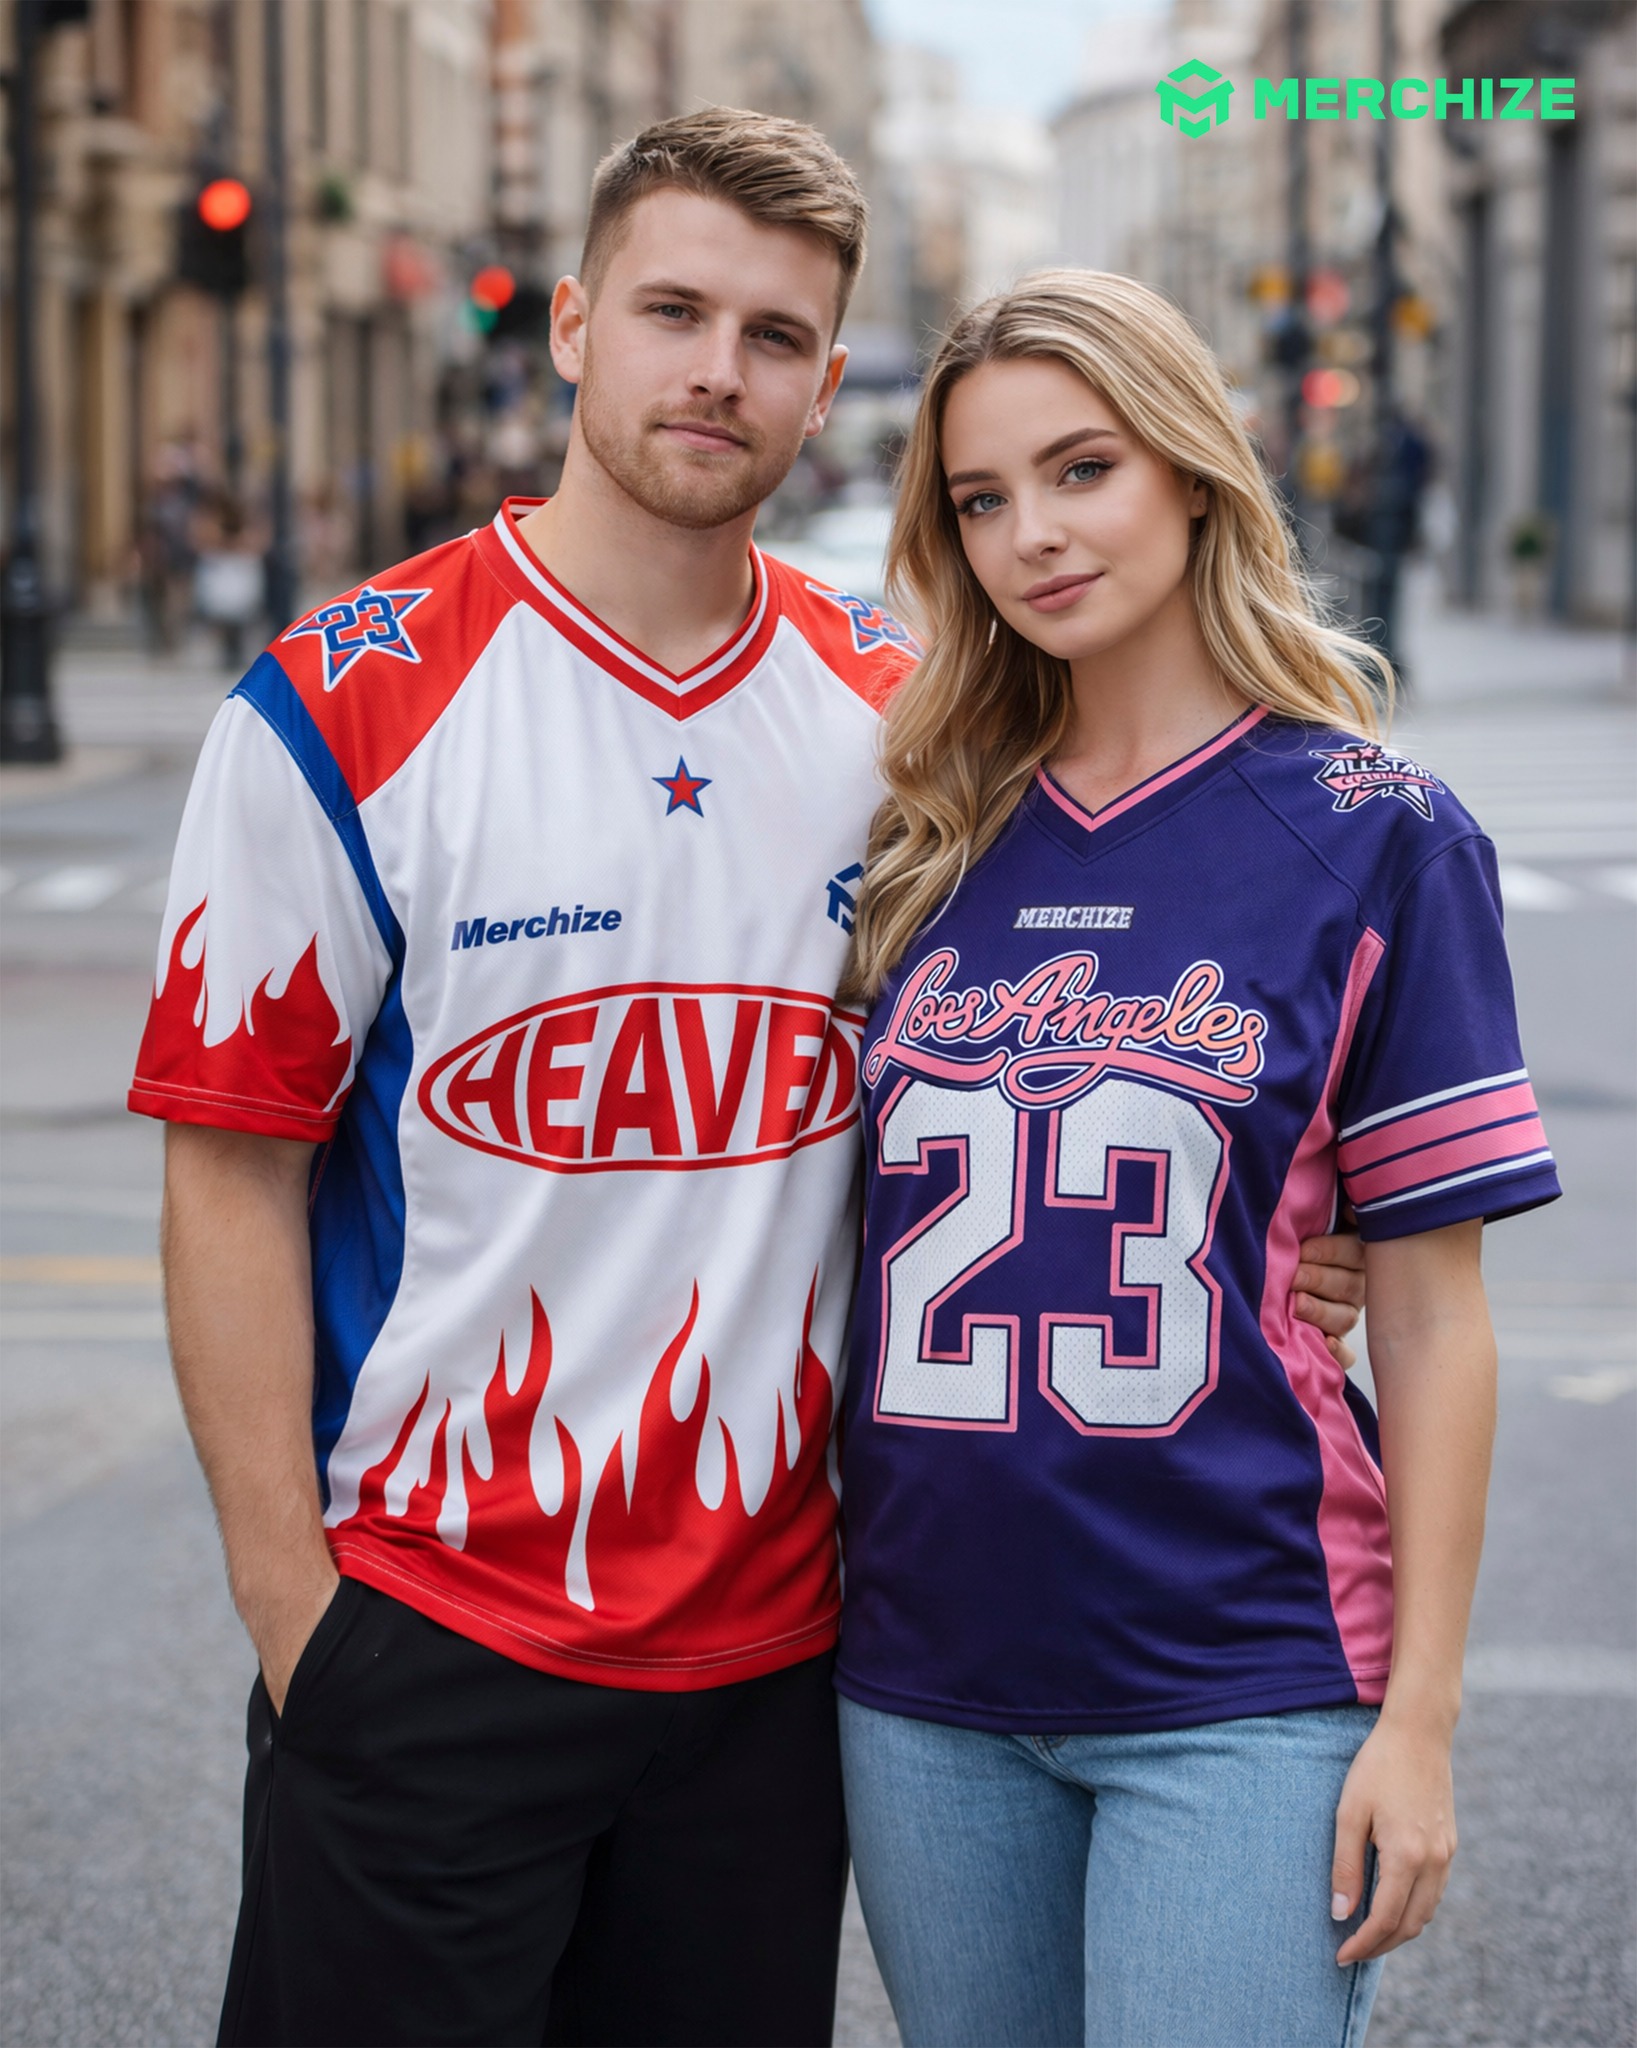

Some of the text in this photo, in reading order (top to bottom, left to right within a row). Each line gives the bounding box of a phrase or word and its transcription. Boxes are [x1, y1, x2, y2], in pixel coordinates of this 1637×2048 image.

[314, 593, 402, 654] 23
[450, 904, 623, 951] Merchize
[1012, 905, 1135, 930] MERCHIZE
[992, 950, 1268, 1110] Angeles
[873, 1075, 1233, 1438] 23
